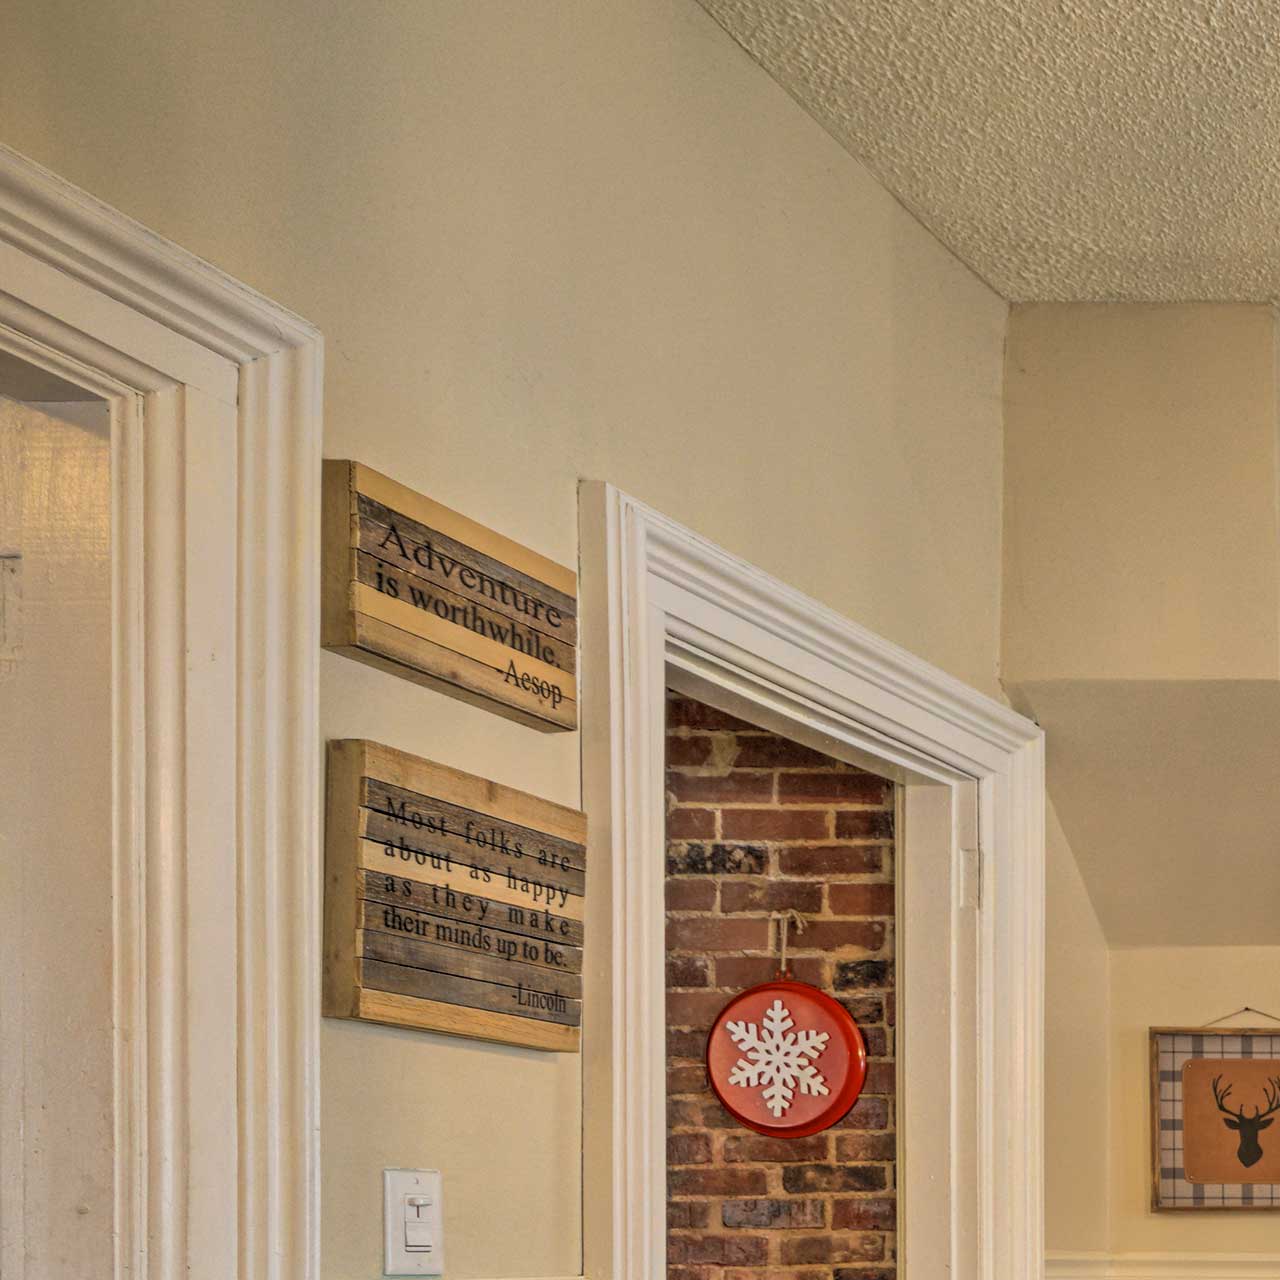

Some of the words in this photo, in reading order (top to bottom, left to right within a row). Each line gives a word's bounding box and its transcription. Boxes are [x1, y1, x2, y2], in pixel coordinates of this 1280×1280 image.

[378, 524, 563, 629] Adventure
[375, 562, 401, 599] is
[408, 583, 561, 669] worthwhile.
[496, 659, 563, 710] -Aesop
[385, 796, 449, 837] Most
[463, 820, 523, 859] folks
[537, 848, 571, 873] are
[383, 837, 453, 873] about
[469, 863, 492, 884] as
[506, 866, 569, 908] happy
[383, 874, 412, 897] as
[431, 885, 490, 920] they
[508, 906, 570, 936] make
[382, 906, 430, 936] their
[435, 921, 492, 951] minds
[496, 937, 518, 962] up
[522, 939, 538, 961] to
[544, 944, 568, 967] be.
[511, 982, 566, 1014] -Lincoln
